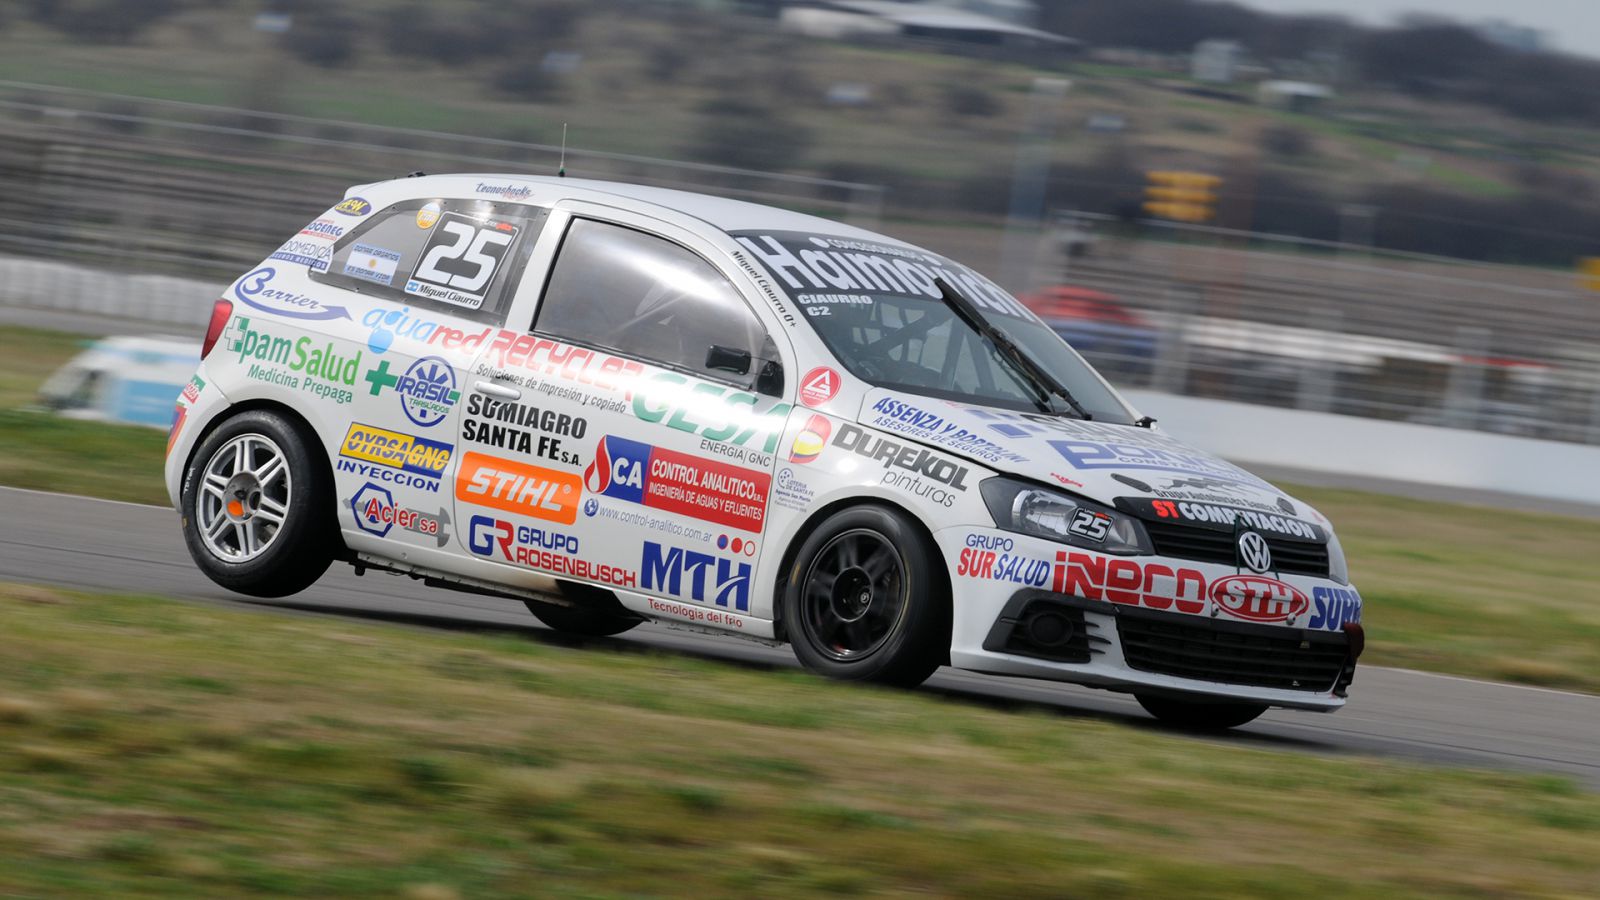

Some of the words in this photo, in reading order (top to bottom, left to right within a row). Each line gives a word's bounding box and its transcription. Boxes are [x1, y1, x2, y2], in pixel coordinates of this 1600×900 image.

[415, 221, 512, 291] 25
[731, 250, 762, 279] Miguel
[418, 284, 448, 299] Miguel
[448, 291, 480, 306] Ciaurro
[797, 294, 873, 305] CIAURRO
[806, 306, 832, 316] C2
[247, 364, 299, 388] Medicina
[302, 377, 354, 404] Prepaga
[476, 363, 523, 385] Soluciones
[525, 376, 537, 388] de
[538, 380, 582, 401] impresión
[582, 394, 590, 406] y
[590, 397, 626, 414] copiado
[467, 394, 587, 439] SUMIAGRO
[872, 397, 944, 431] ASSENZA
[940, 422, 958, 434] Y
[462, 419, 531, 454] SANTA
[537, 436, 561, 461] FE
[561, 451, 582, 467] S.A.
[832, 423, 968, 491] DUREKOL
[873, 416, 932, 438] ASESORES
[931, 434, 947, 444] DE
[948, 438, 1001, 463] SEGUROS
[337, 460, 440, 493] INYECCION
[612, 458, 642, 489] CA
[748, 452, 771, 467] GNC
[466, 466, 562, 512] STIHL
[652, 459, 699, 486] CONTROL
[700, 471, 755, 499] ANALITICO
[880, 470, 956, 508] pinturas
[366, 497, 418, 528] Acier
[420, 518, 437, 534] sa
[649, 482, 685, 501] INGENIERÍA
[685, 490, 695, 504] DE
[695, 494, 718, 510] AGUAS
[719, 499, 725, 511] Y
[724, 500, 762, 520] EFLUENTES
[1151, 500, 1180, 519] ST
[469, 515, 515, 561] GR
[518, 526, 579, 554] GRUPO
[599, 506, 712, 544] www.control-analitico.com.ar
[966, 533, 1014, 552] GRUPO
[1070, 511, 1111, 540] 25
[516, 546, 636, 588] ROSENBUSCH
[641, 541, 752, 612] MTH
[648, 597, 704, 621] Tecnologia
[707, 606, 722, 624] del
[1222, 579, 1293, 614] STH
